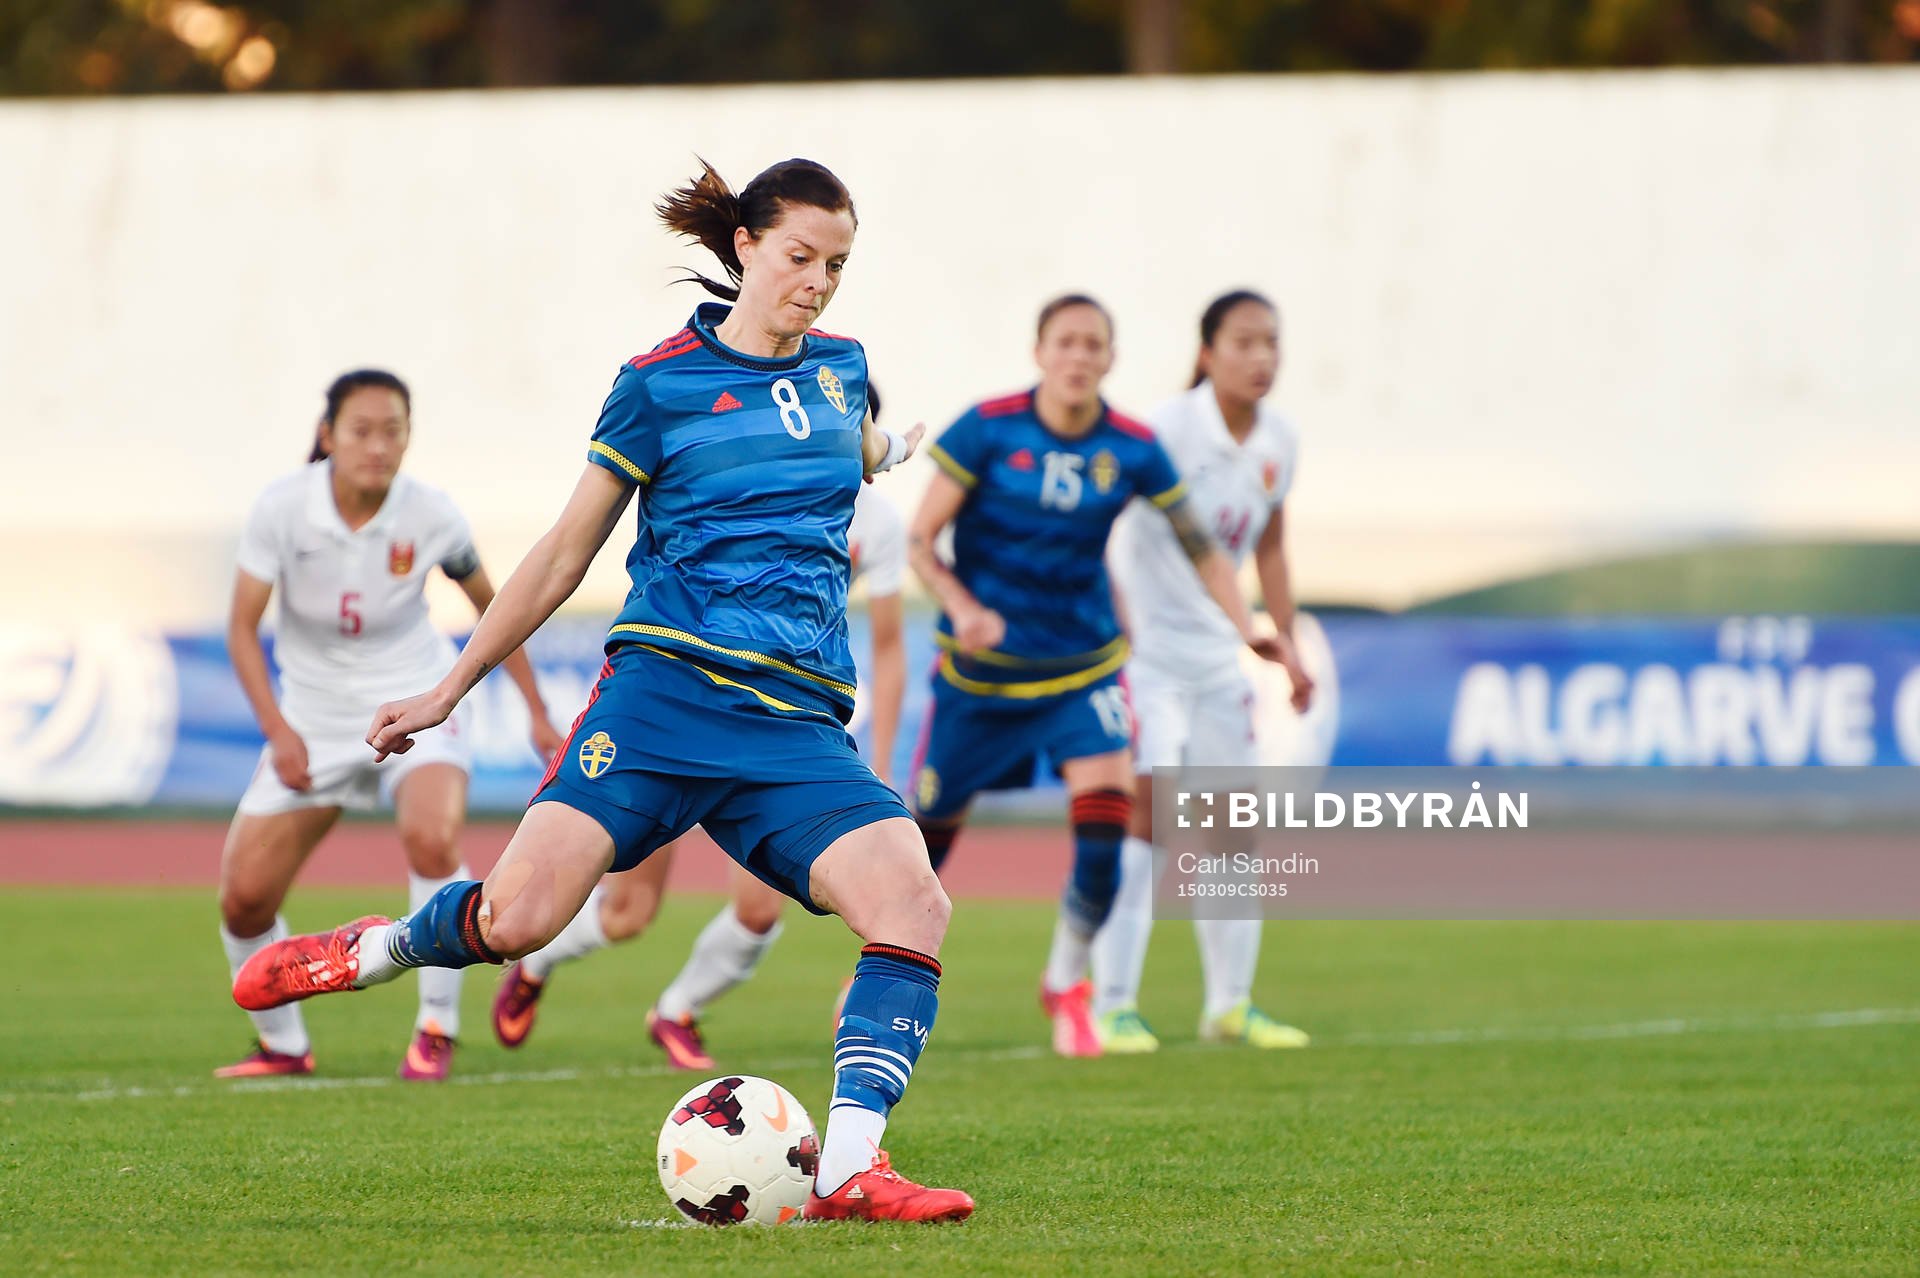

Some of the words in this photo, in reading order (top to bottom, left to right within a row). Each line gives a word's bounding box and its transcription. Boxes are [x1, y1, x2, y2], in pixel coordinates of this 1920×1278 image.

[771, 378, 811, 440] 8
[1041, 450, 1085, 512] 15
[339, 591, 363, 637] 5
[1448, 661, 1877, 767] ALGARVE
